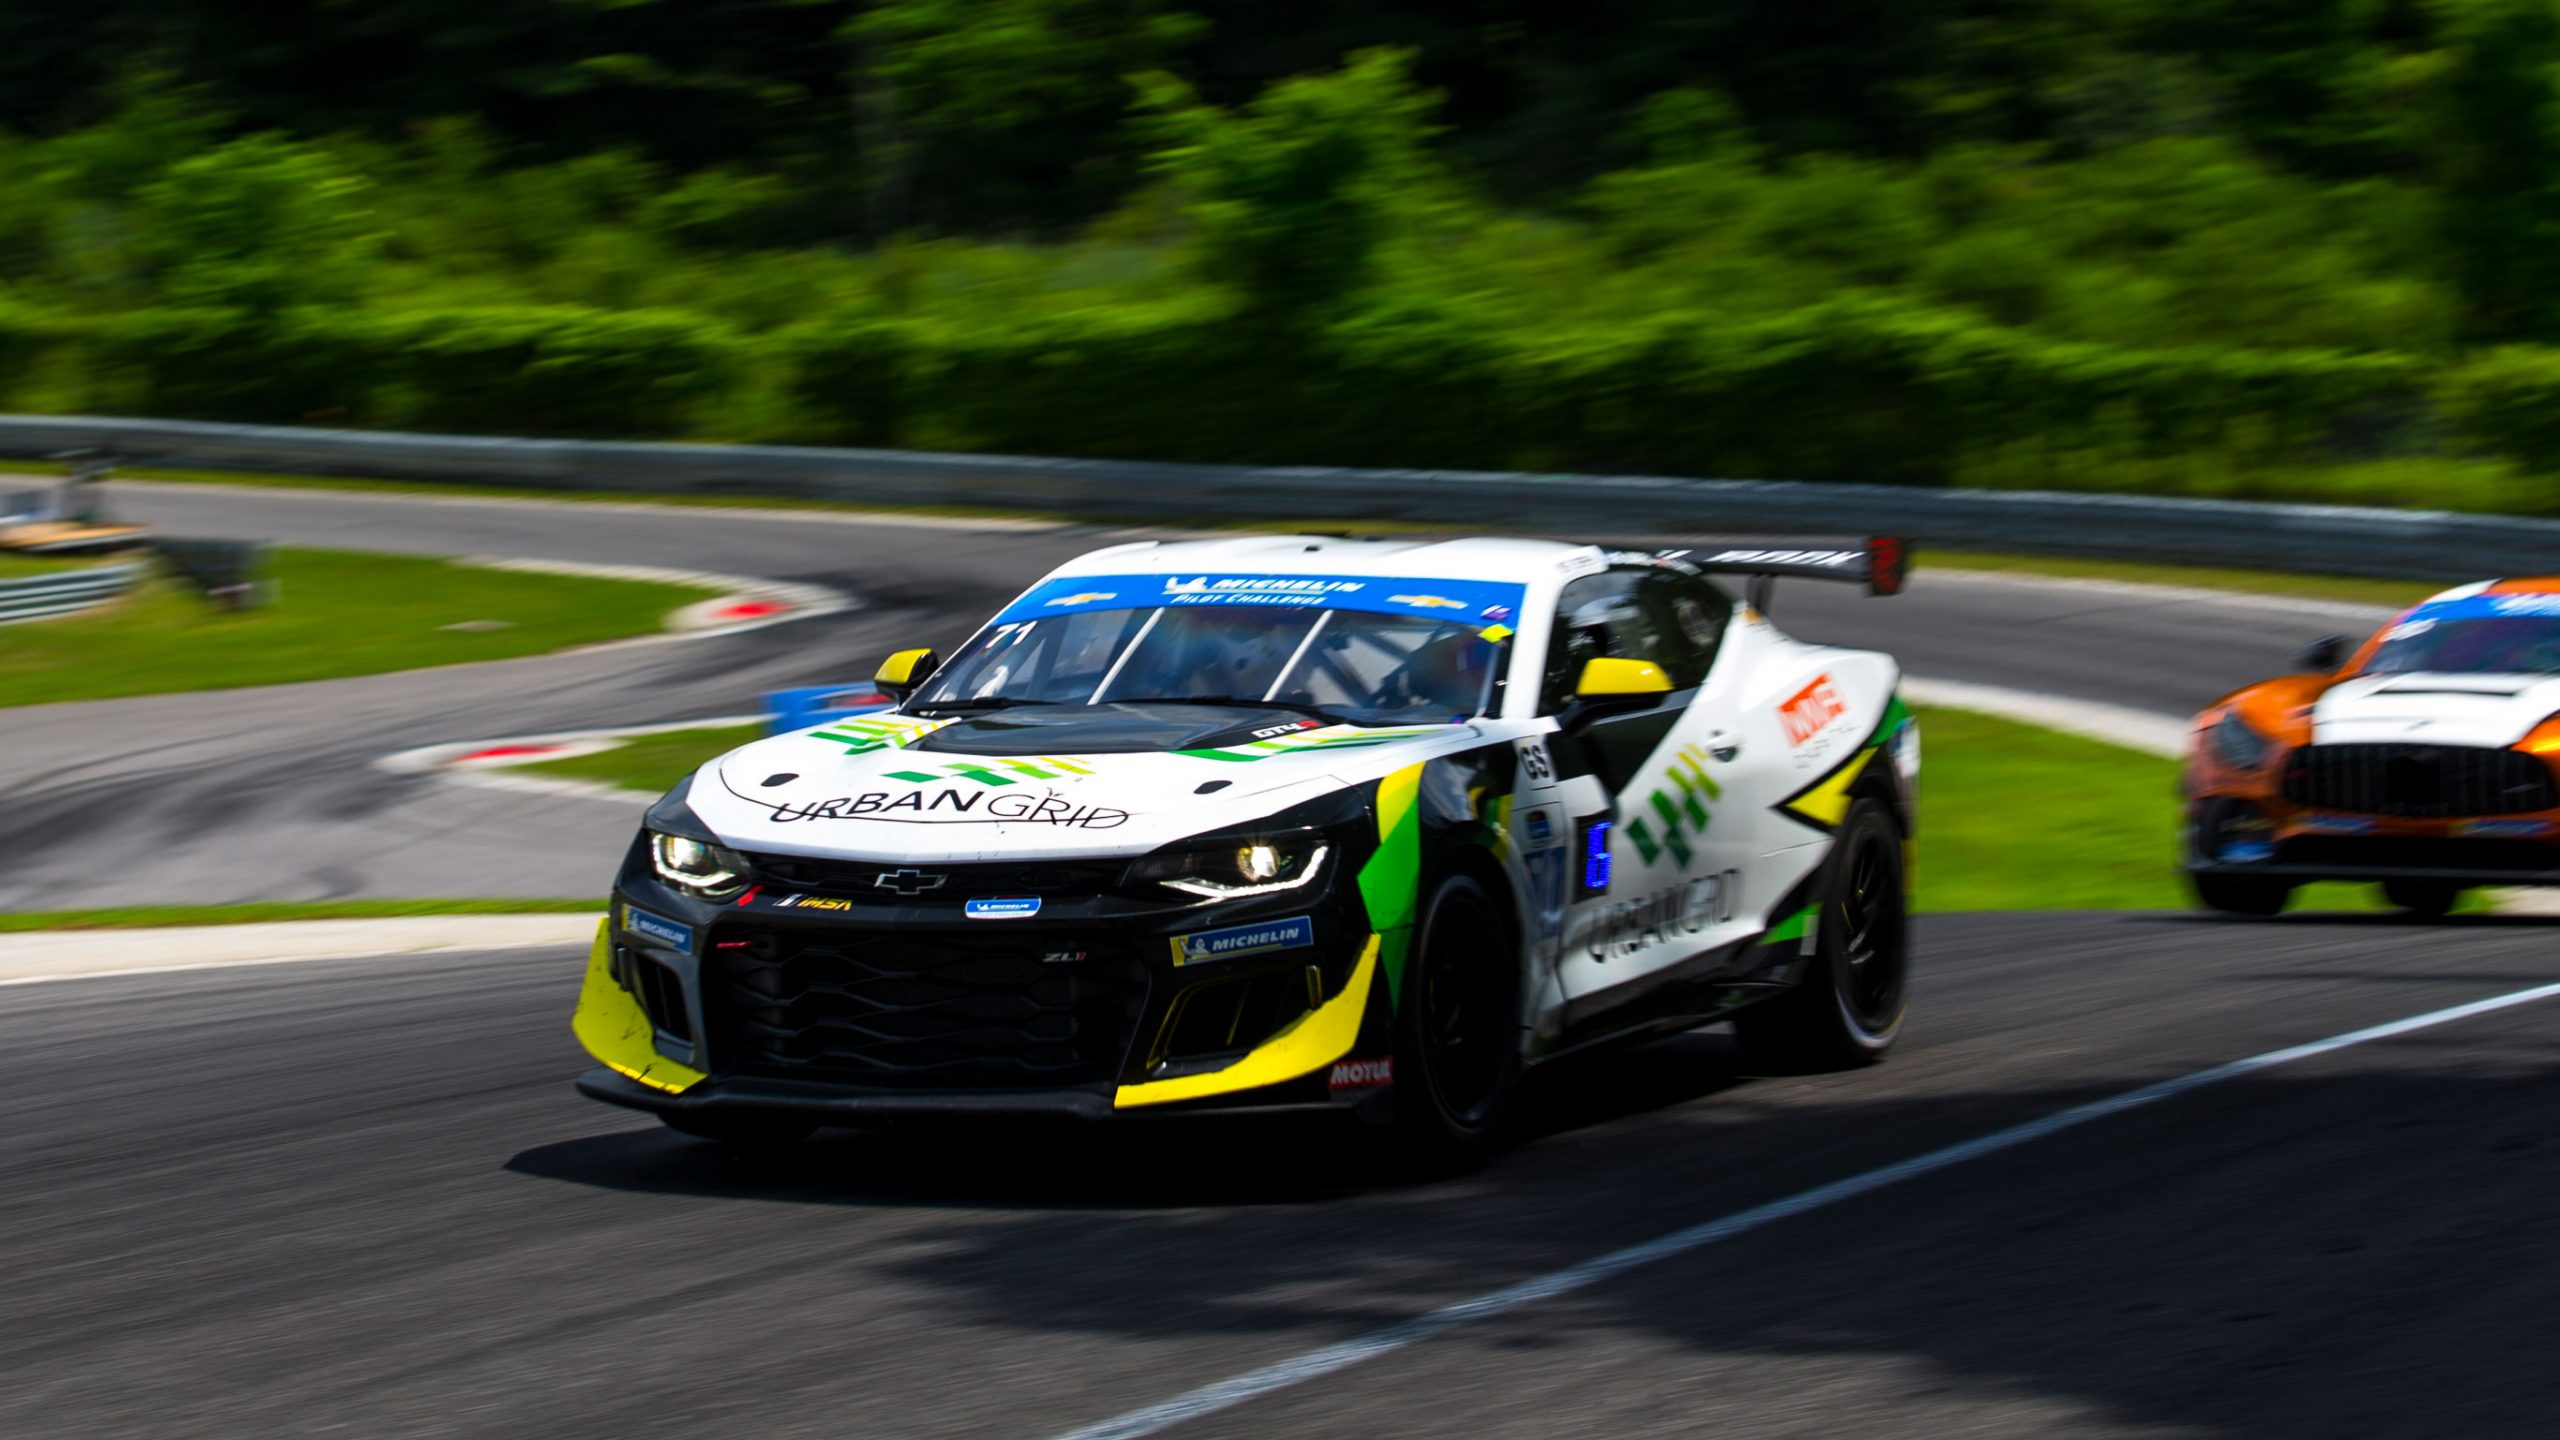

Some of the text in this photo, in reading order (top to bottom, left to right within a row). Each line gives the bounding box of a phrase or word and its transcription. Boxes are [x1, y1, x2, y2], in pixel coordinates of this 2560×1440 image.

[1211, 578, 1367, 593] MICHELIN
[985, 620, 1038, 649] 71
[1520, 745, 1550, 780] GS
[1212, 927, 1300, 951] MICHELIN
[1329, 1060, 1391, 1084] MOTUL
